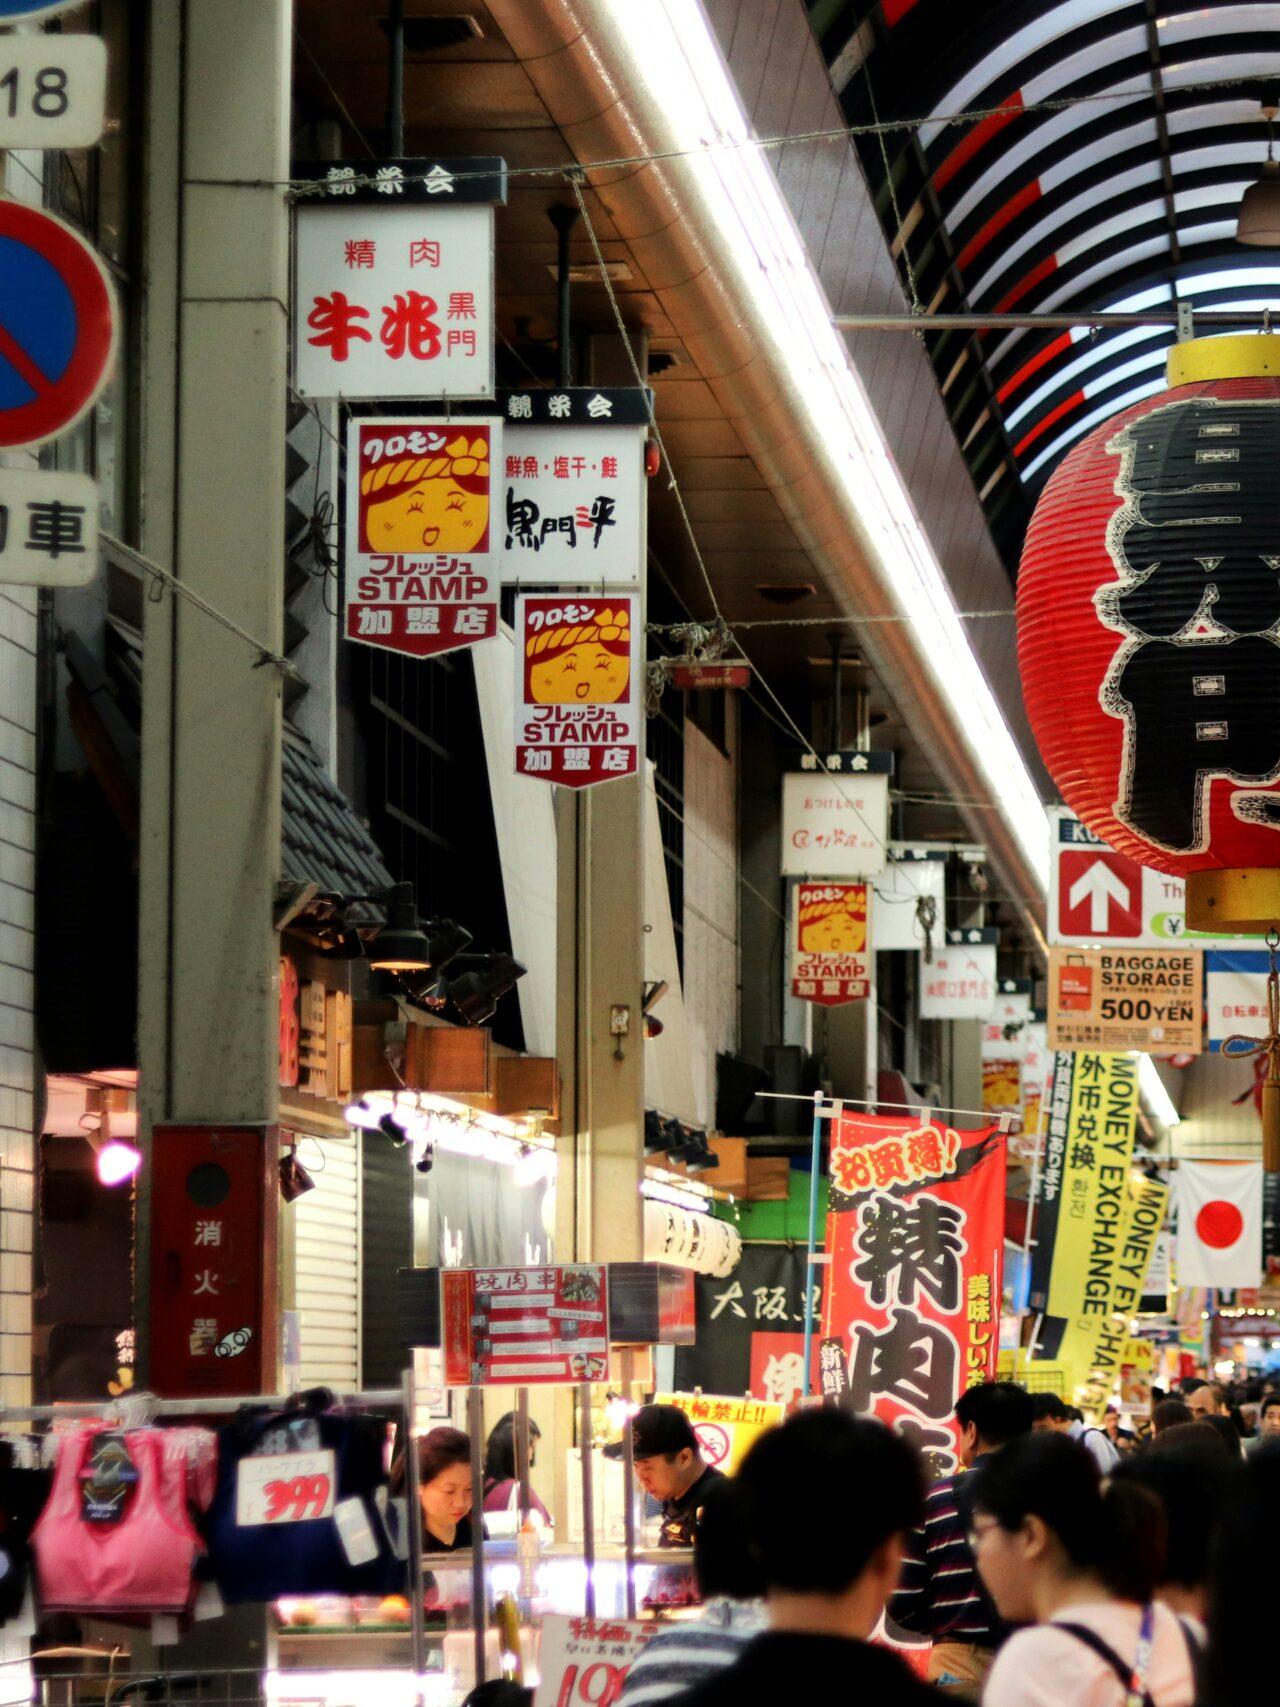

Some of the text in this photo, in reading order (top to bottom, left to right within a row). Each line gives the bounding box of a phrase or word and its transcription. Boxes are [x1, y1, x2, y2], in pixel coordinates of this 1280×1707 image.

[344, 237, 441, 269] 精肉
[446, 291, 477, 357] 黒門
[508, 394, 614, 419] 親栄会
[364, 430, 447, 464] クロモン
[369, 555, 474, 576] フレッシュ
[357, 576, 489, 601] STAMP
[357, 606, 489, 635] 加盟店
[527, 603, 596, 634] クロモン
[533, 705, 617, 722] フレッシュ
[524, 722, 630, 744] STAMP
[524, 747, 630, 772] 加盟店
[800, 888, 845, 906] クロモン
[798, 964, 866, 977] STAMP
[803, 953, 857, 966] フレッシュ
[1101, 957, 1194, 971] BAGGAGE
[799, 981, 865, 997] 加盟店
[1101, 973, 1194, 987] STORAGE
[1101, 999, 1193, 1021] 500 YEN
[1103, 1057, 1136, 1157] MONEY
[1082, 1164, 1125, 1317] EXCHANGE
[1119, 1187, 1164, 1279] MONEY
[264, 1474, 330, 1521] 399
